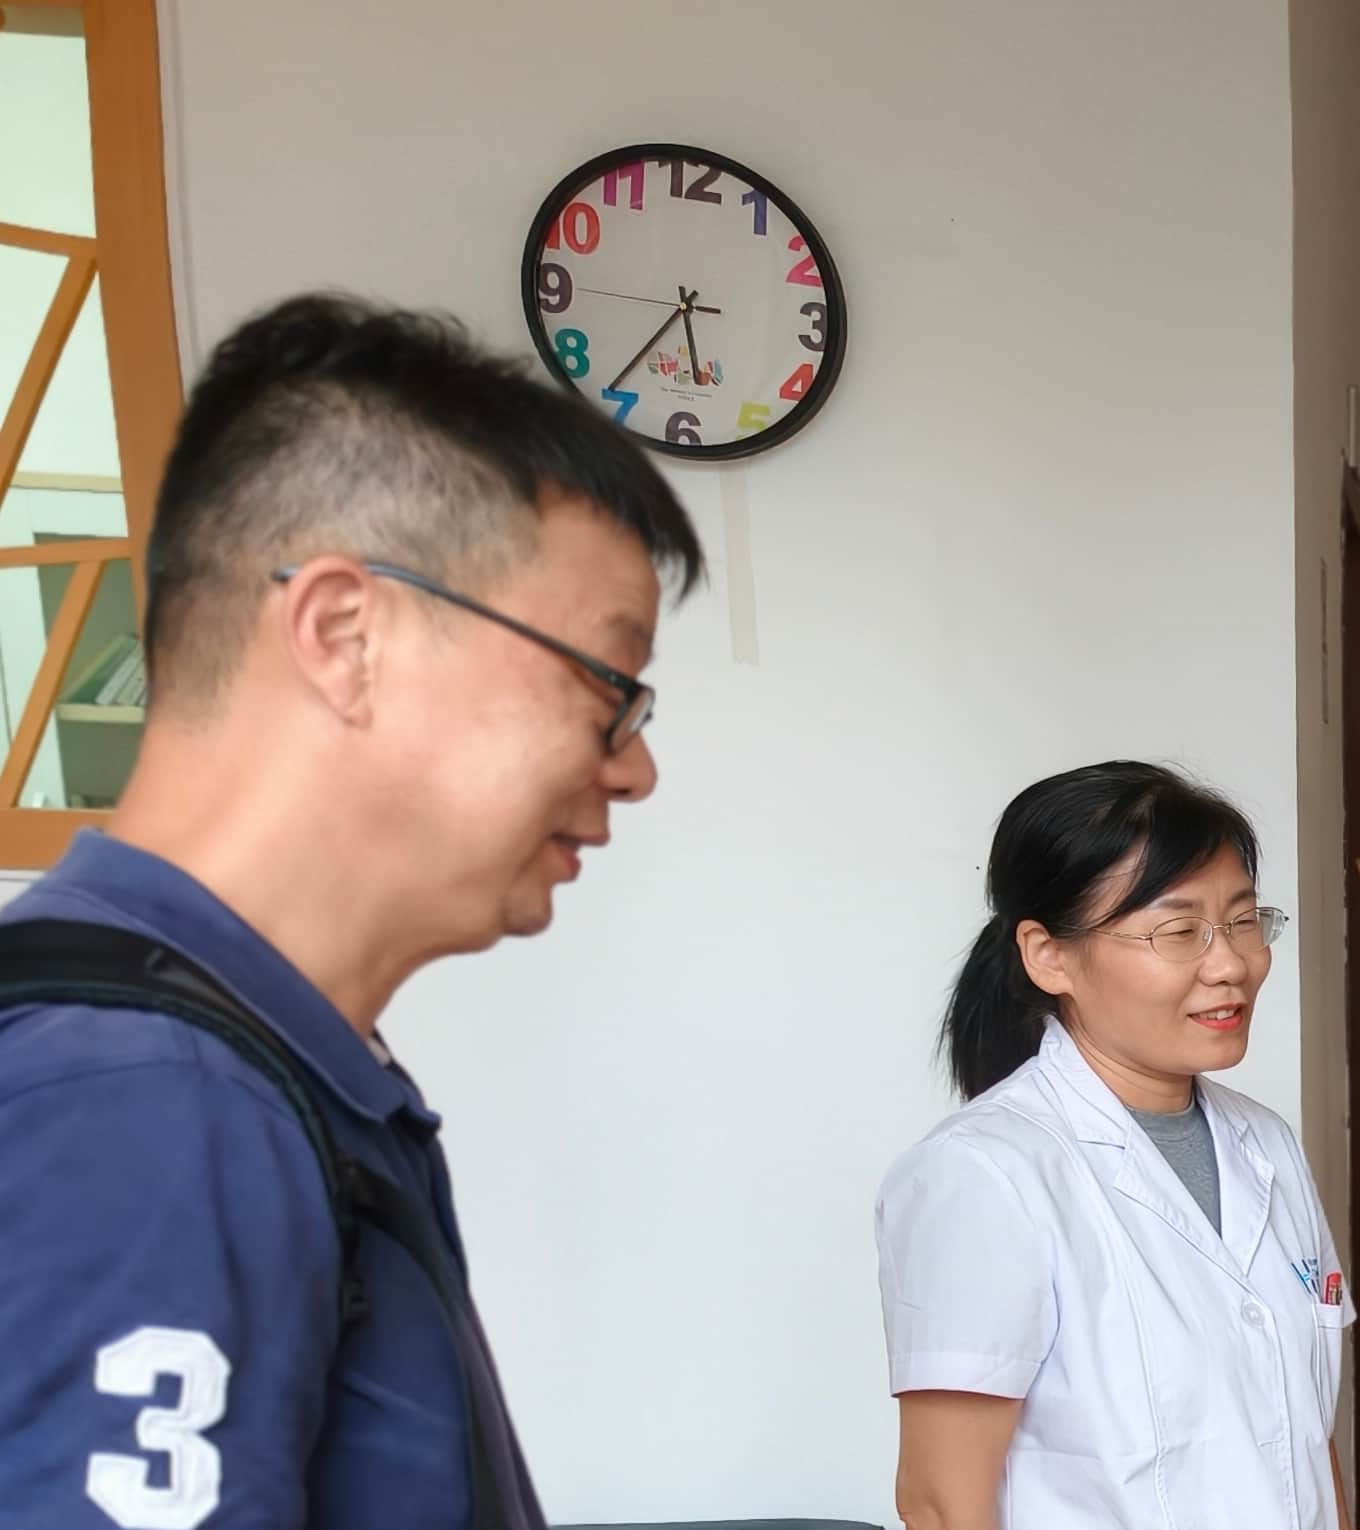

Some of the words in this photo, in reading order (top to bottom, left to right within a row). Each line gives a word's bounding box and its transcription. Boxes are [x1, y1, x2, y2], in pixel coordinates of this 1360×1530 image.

[603, 161, 646, 210] 11
[658, 161, 723, 205] 12
[544, 202, 600, 255] 10
[742, 188, 768, 236] 1
[785, 234, 824, 288] 2
[538, 262, 573, 314] 9
[798, 302, 827, 353] 3
[555, 328, 590, 379] 8
[779, 363, 814, 401] 4
[602, 388, 639, 426] 7
[665, 411, 703, 446] 6
